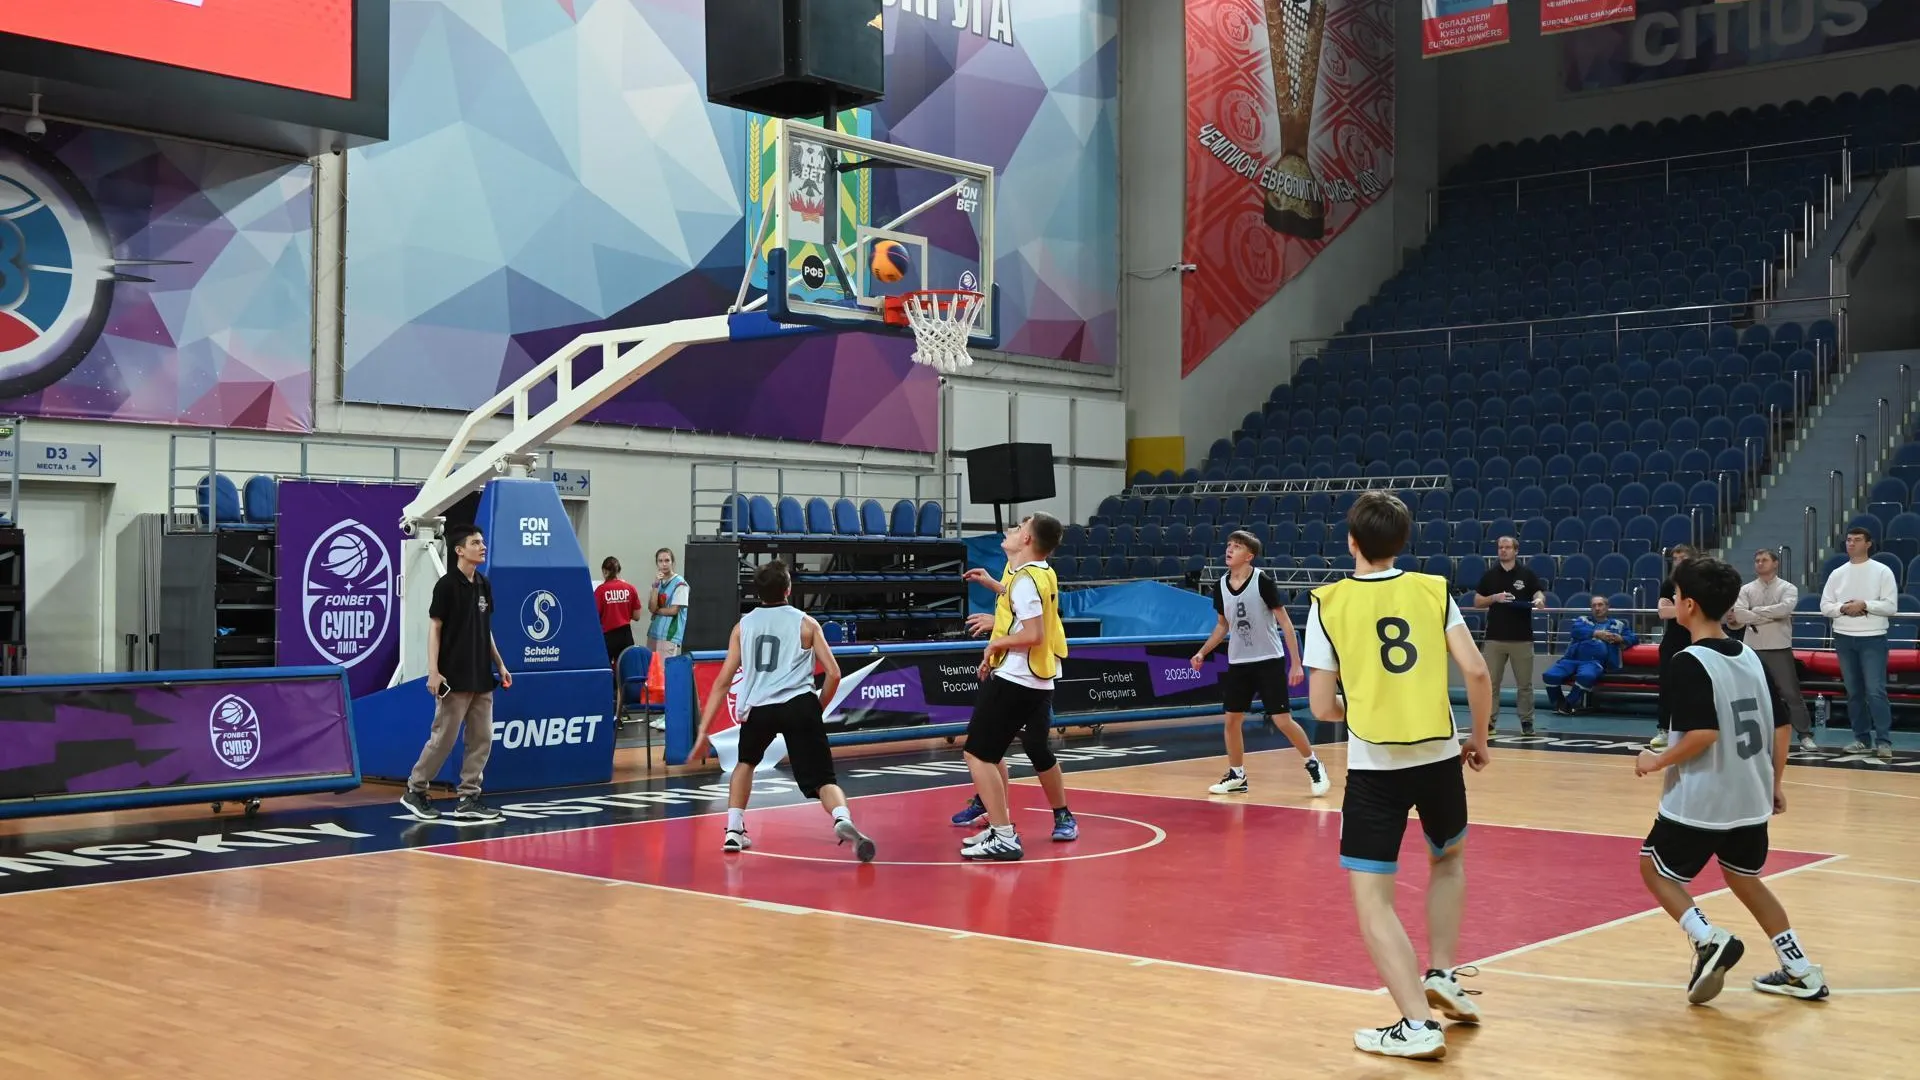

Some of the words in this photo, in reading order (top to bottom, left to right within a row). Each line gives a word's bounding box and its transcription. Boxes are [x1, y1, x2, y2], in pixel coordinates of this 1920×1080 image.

[1438, 12, 1491, 29] ОБЛАДАТЕЛИ
[1542, 14, 1589, 27] EUROLEAGUE
[1440, 27, 1466, 38] КУБКА
[1467, 23, 1489, 33] ФИБА
[1631, 0, 1869, 67] CITIUS
[1198, 122, 1260, 181] ЧЕМПИОН
[1260, 166, 1322, 202] ЕВРОЛИГИ
[801, 167, 826, 182] BET
[956, 185, 978, 200] FON
[956, 199, 978, 212] BET
[804, 266, 824, 279] РФБ
[46, 447, 68, 460] D3
[553, 472, 568, 482] D4
[520, 517, 548, 531] FON
[522, 532, 551, 546] BET
[324, 594, 373, 606] FONBET
[605, 589, 630, 601] СШОР
[1236, 602, 1247, 618] 8
[320, 610, 375, 640] СУПЕР
[337, 641, 357, 654] ЛИГА
[524, 646, 560, 656] Schelde
[1376, 616, 1418, 674] 8
[524, 655, 560, 663] International
[755, 634, 781, 673] 0
[1102, 671, 1133, 683] Fonbet
[1165, 667, 1201, 680] 2025/26
[861, 683, 905, 699] FONBET
[942, 681, 979, 692] России
[1089, 687, 1137, 700] Суперлига
[223, 731, 250, 739] FONBET
[491, 714, 603, 749] FONBET
[1730, 697, 1763, 760] 5
[222, 740, 252, 756] СУПЕР
[0, 822, 376, 877] NSKIY
